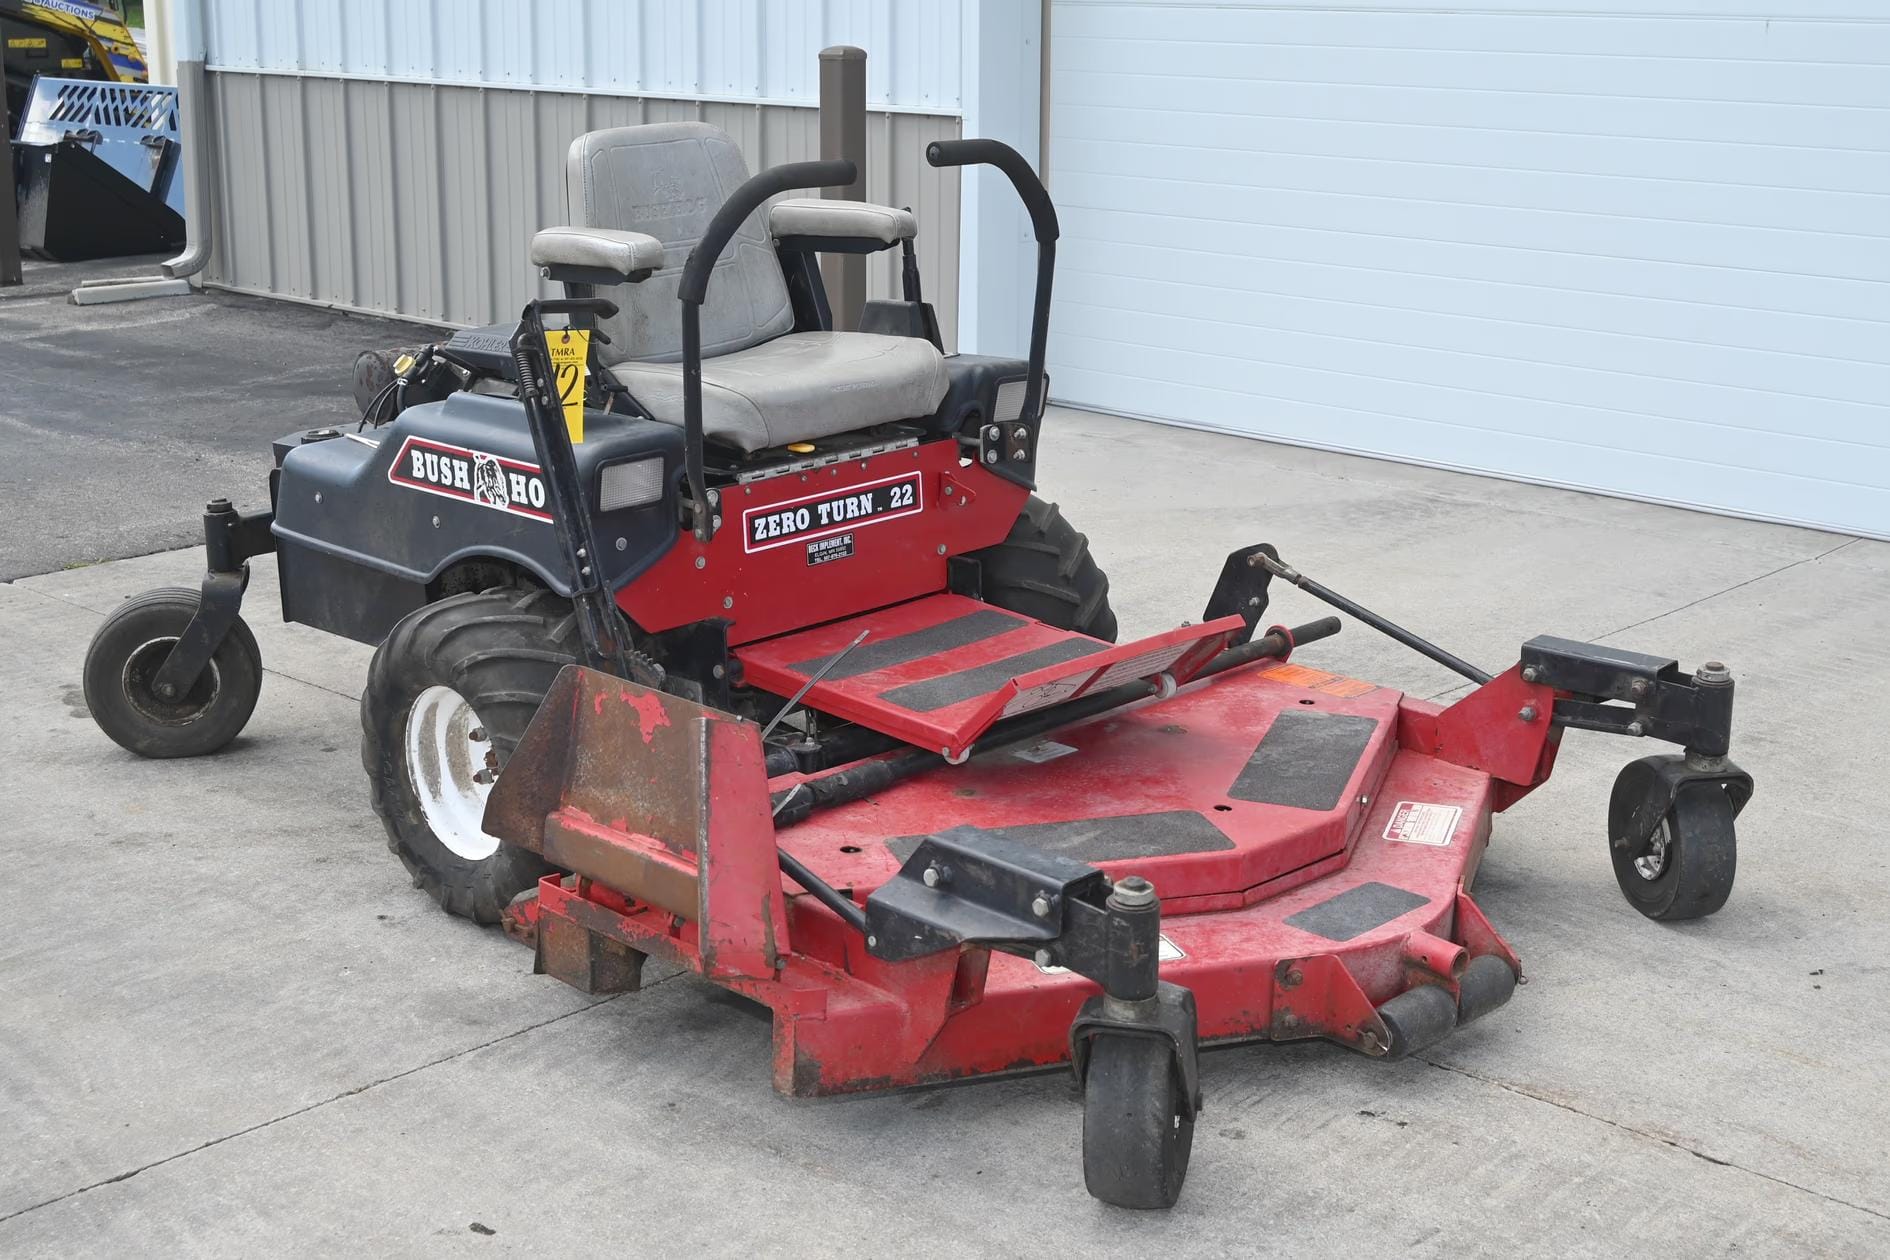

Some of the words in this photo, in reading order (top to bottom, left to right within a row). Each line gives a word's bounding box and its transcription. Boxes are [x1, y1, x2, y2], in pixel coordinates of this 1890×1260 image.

[43, 0, 94, 19] AUCTIONS
[466, 335, 510, 353] KOHLER
[551, 347, 575, 356] TMRA
[410, 449, 471, 490] BUSH
[508, 472, 546, 509] HO
[754, 507, 811, 541] ZERO
[817, 492, 873, 526] TURN
[890, 483, 913, 509] 22
